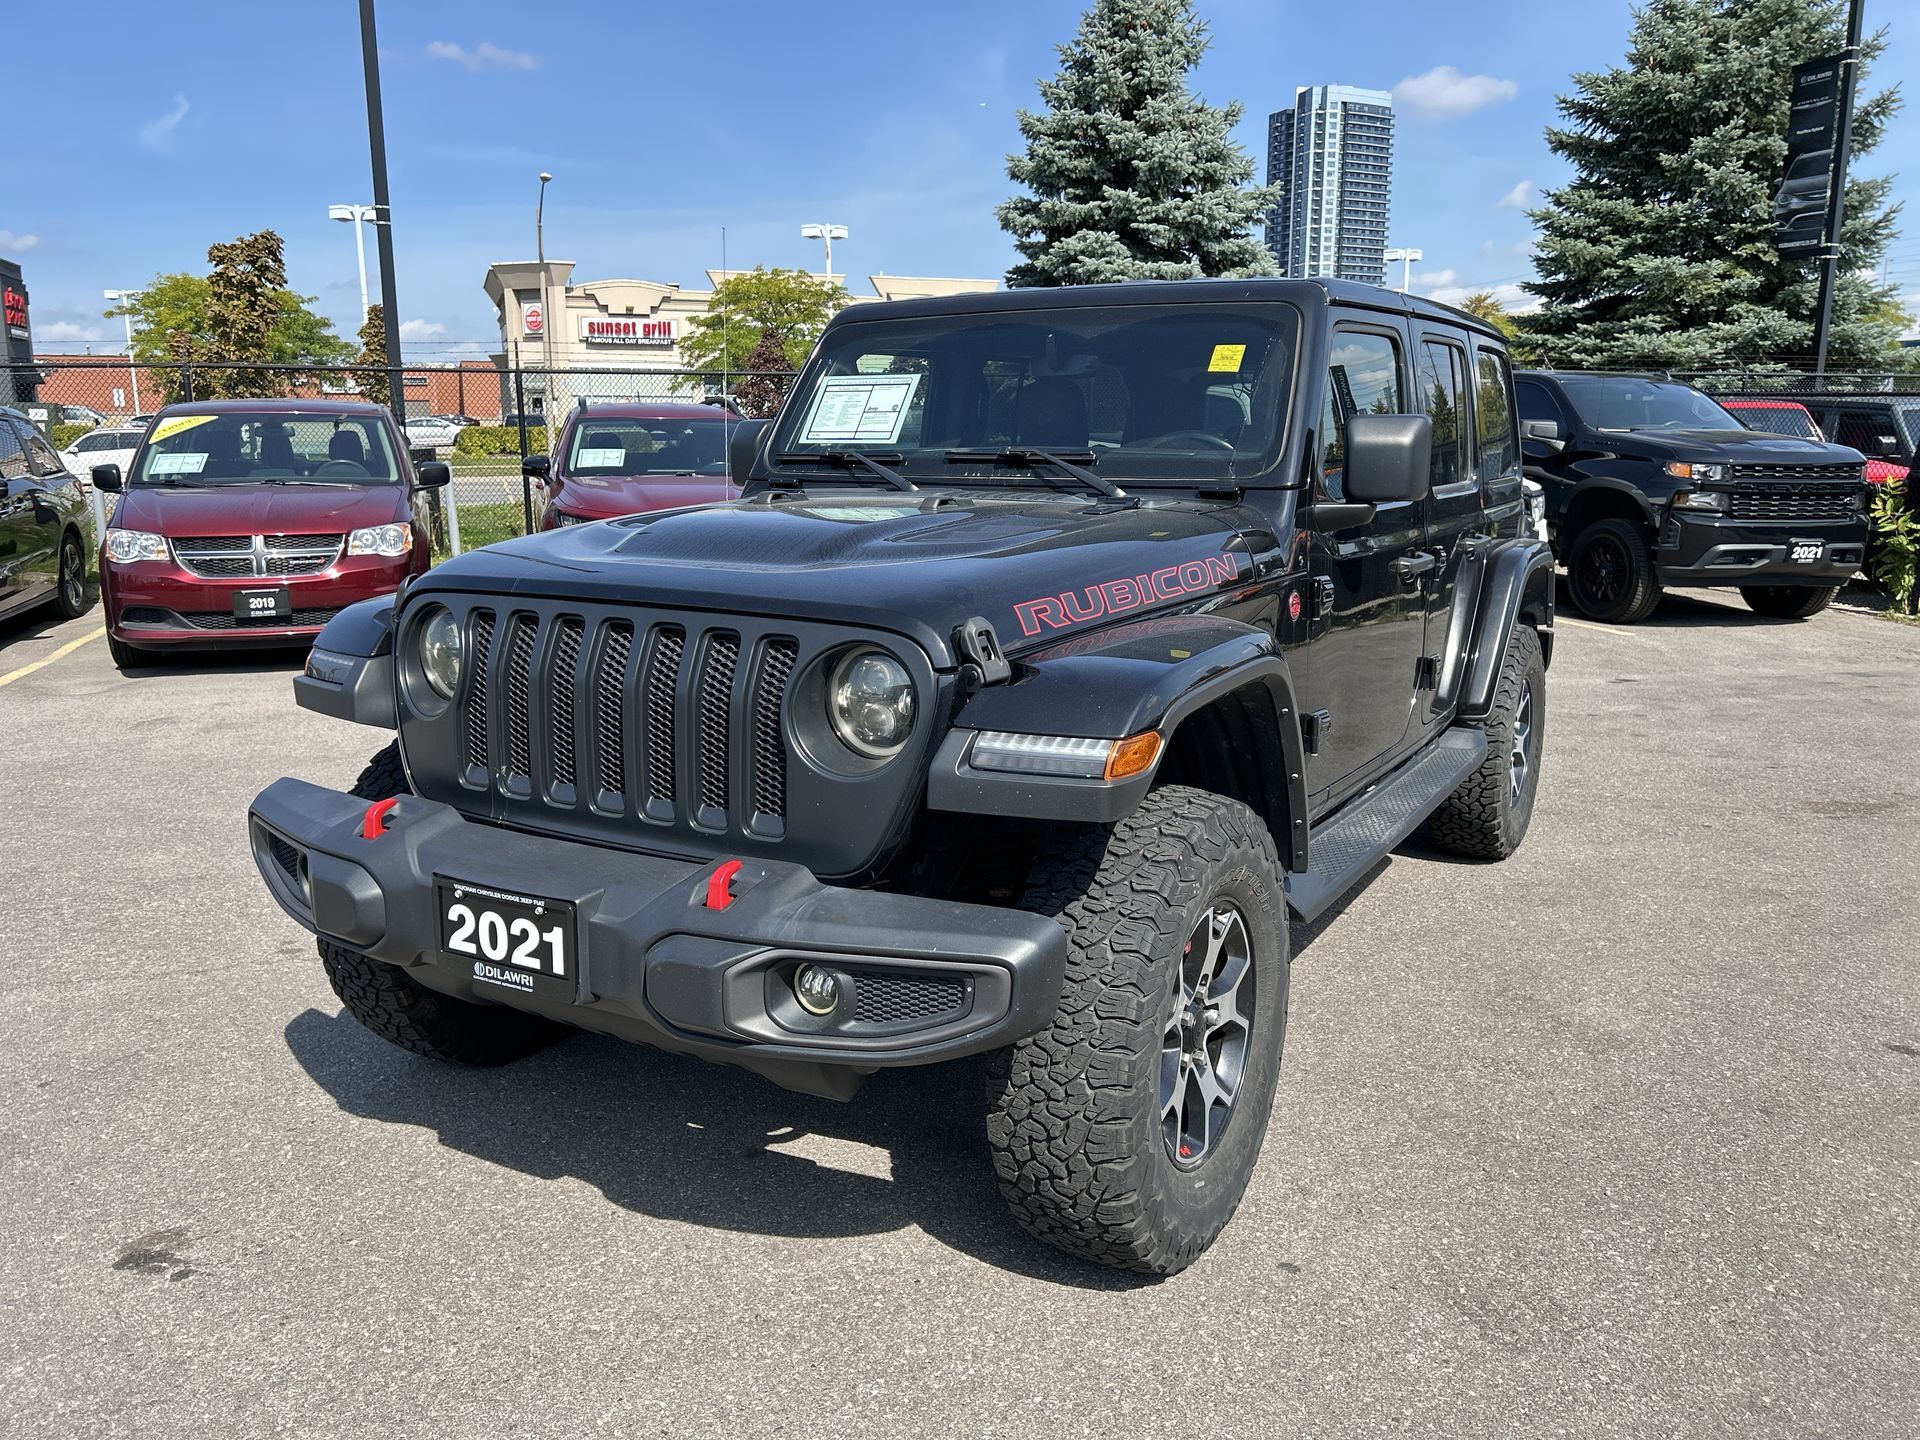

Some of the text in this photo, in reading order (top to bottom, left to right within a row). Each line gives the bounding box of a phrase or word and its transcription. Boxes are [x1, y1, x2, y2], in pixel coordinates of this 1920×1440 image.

[588, 321, 671, 337] sunset grill
[1791, 546, 1823, 559] 2021
[249, 597, 275, 608] 2019
[1013, 553, 1239, 637] RUBICON
[447, 903, 565, 976] 2021
[485, 965, 534, 987] DILAWRI
